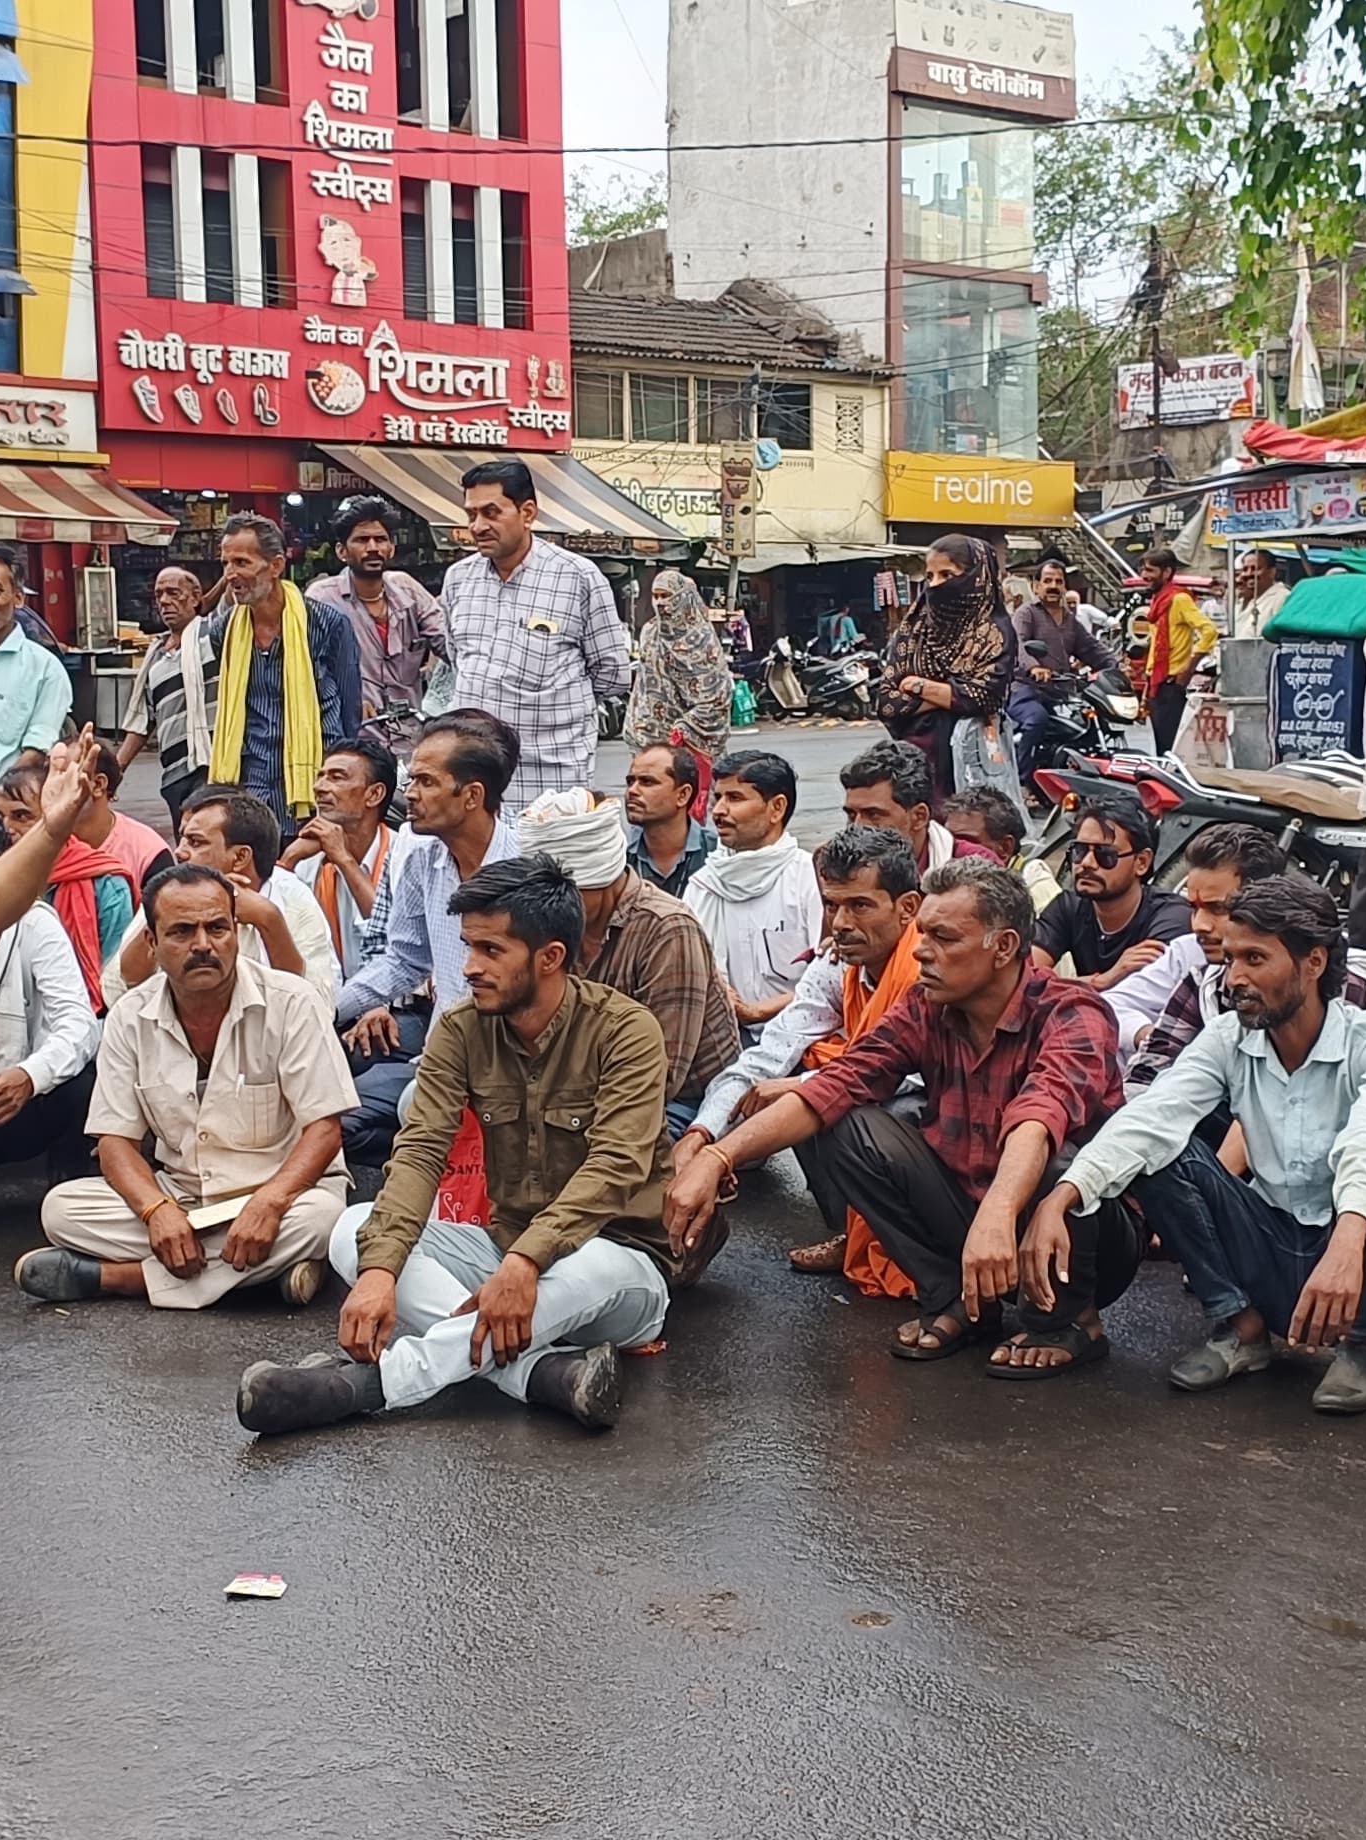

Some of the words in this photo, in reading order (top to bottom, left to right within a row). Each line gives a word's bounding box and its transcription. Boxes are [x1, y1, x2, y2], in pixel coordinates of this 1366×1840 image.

[319, 22, 374, 74] जैन
[328, 80, 368, 114] का
[927, 61, 968, 94] वासु
[968, 63, 1045, 100] टेलीकॉम
[303, 99, 395, 166] शिमला
[309, 162, 393, 213] स्वीट्स
[304, 315, 335, 344] जैन
[338, 326, 364, 346] का
[118, 329, 186, 371] चौधरी
[189, 343, 224, 384] बूट
[227, 346, 291, 379] हाऊस
[364, 320, 512, 411] शिमला
[508, 400, 572, 439] स्वीट्स
[935, 472, 1033, 505] realme
